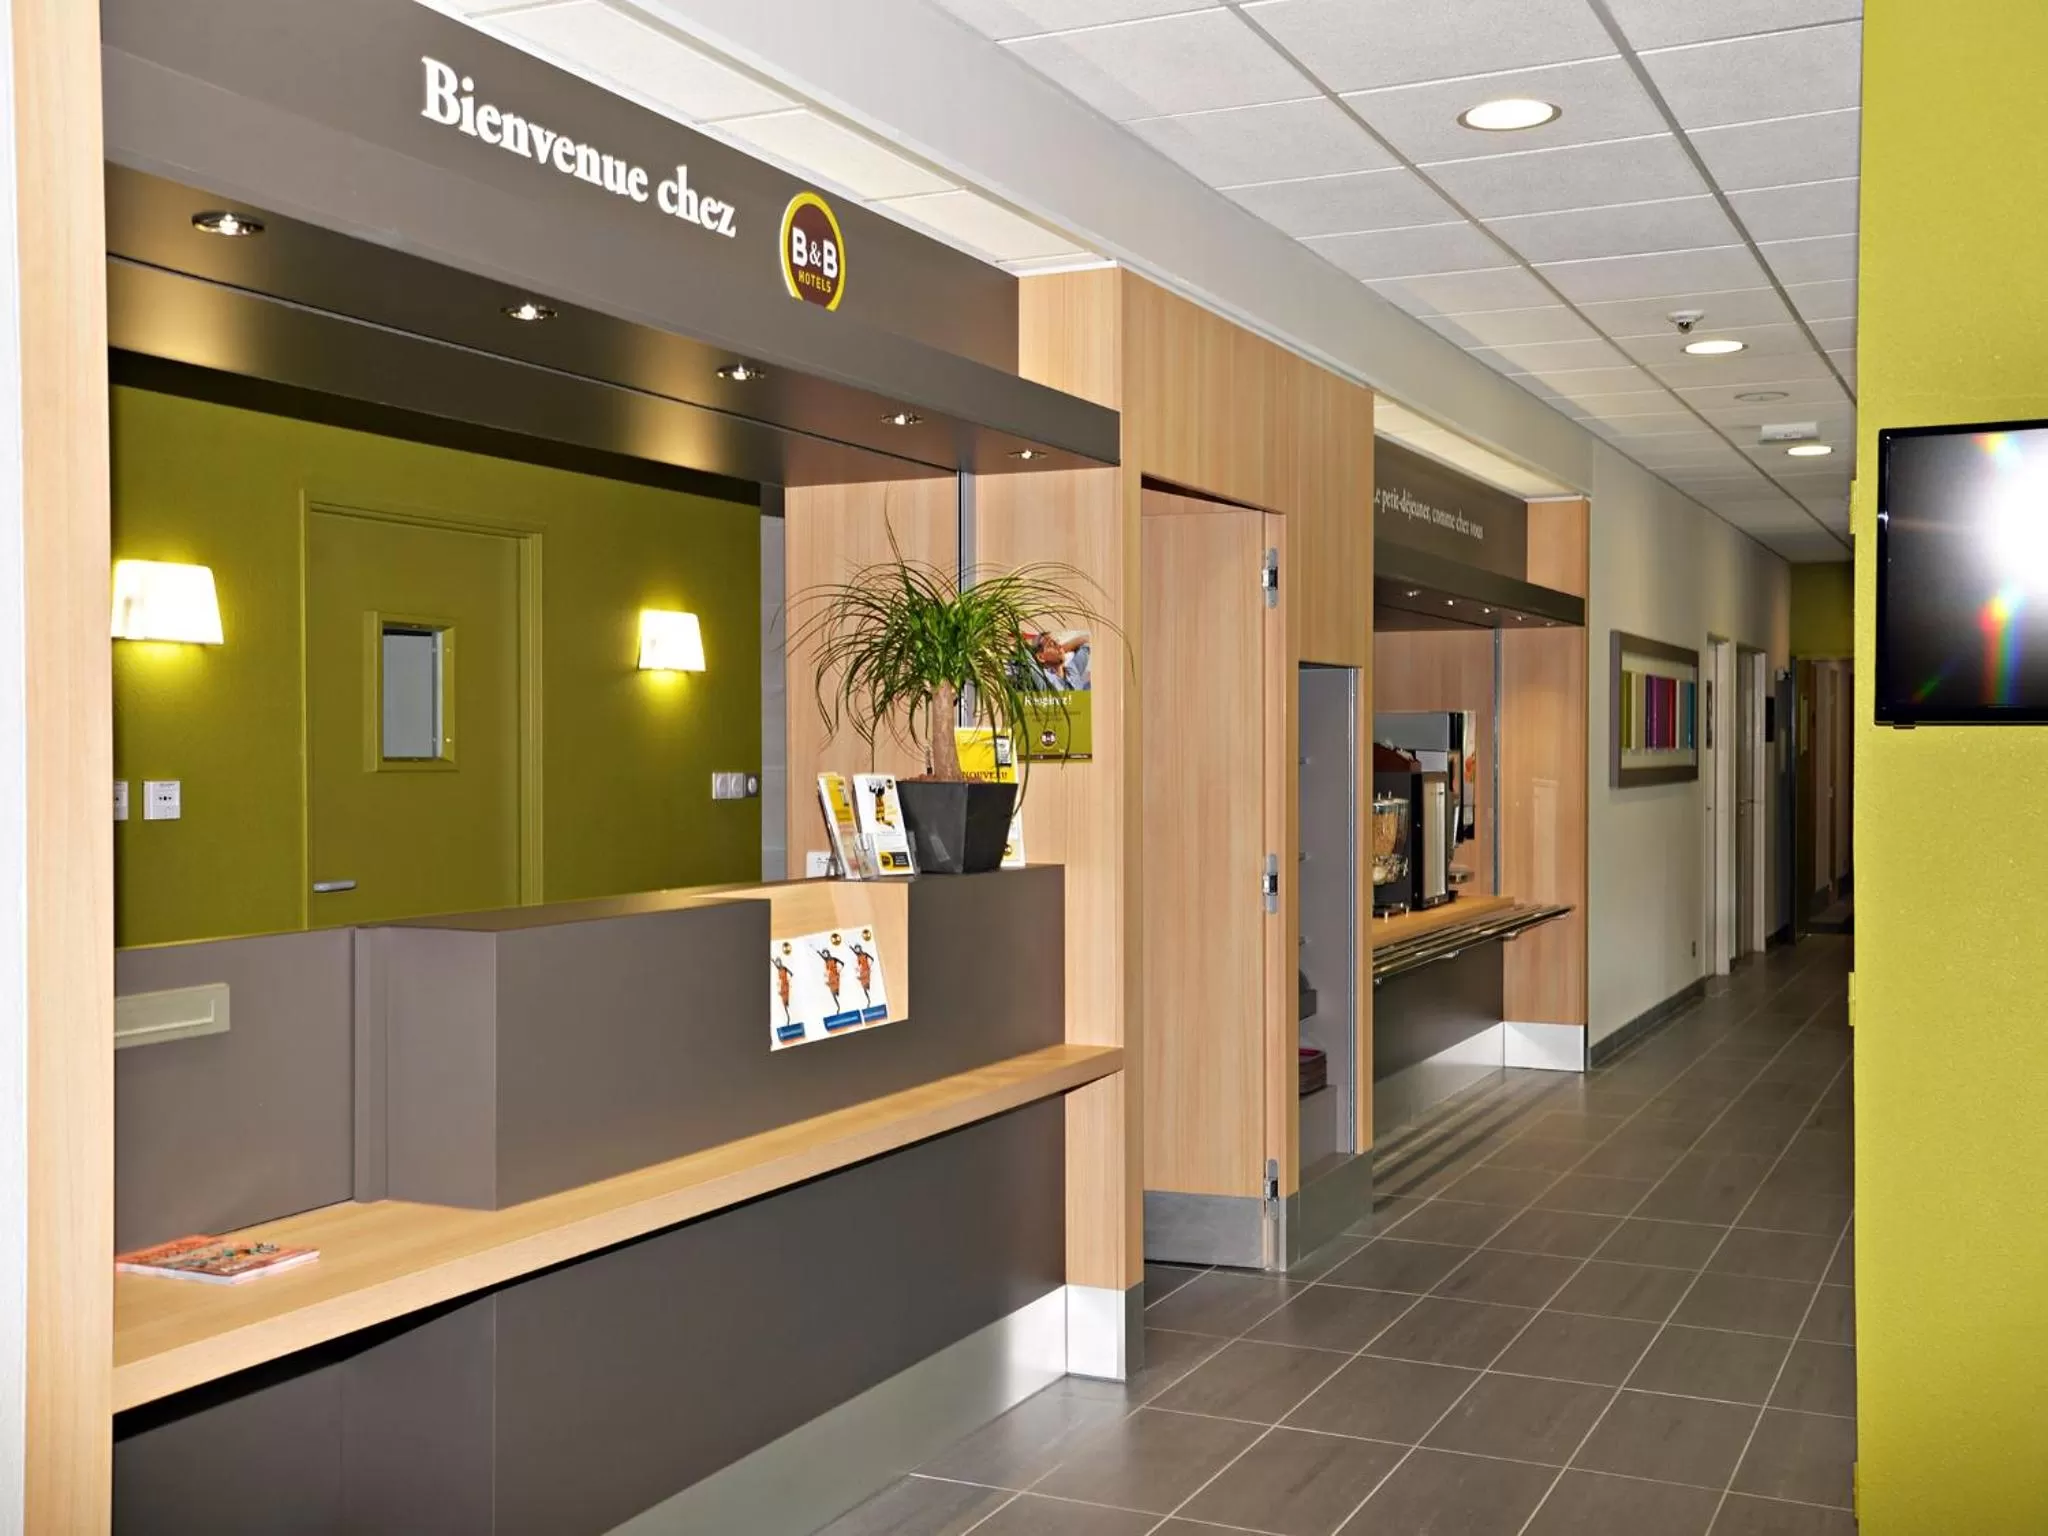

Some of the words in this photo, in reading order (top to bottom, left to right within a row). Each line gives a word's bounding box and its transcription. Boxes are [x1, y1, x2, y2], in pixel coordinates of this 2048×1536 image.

[420, 55, 649, 203] Bienvenue
[657, 163, 737, 238] chez
[792, 226, 838, 279] B&B
[798, 269, 832, 293] HOTELS
[1432, 507, 1455, 530] comme
[1456, 508, 1469, 535] chez
